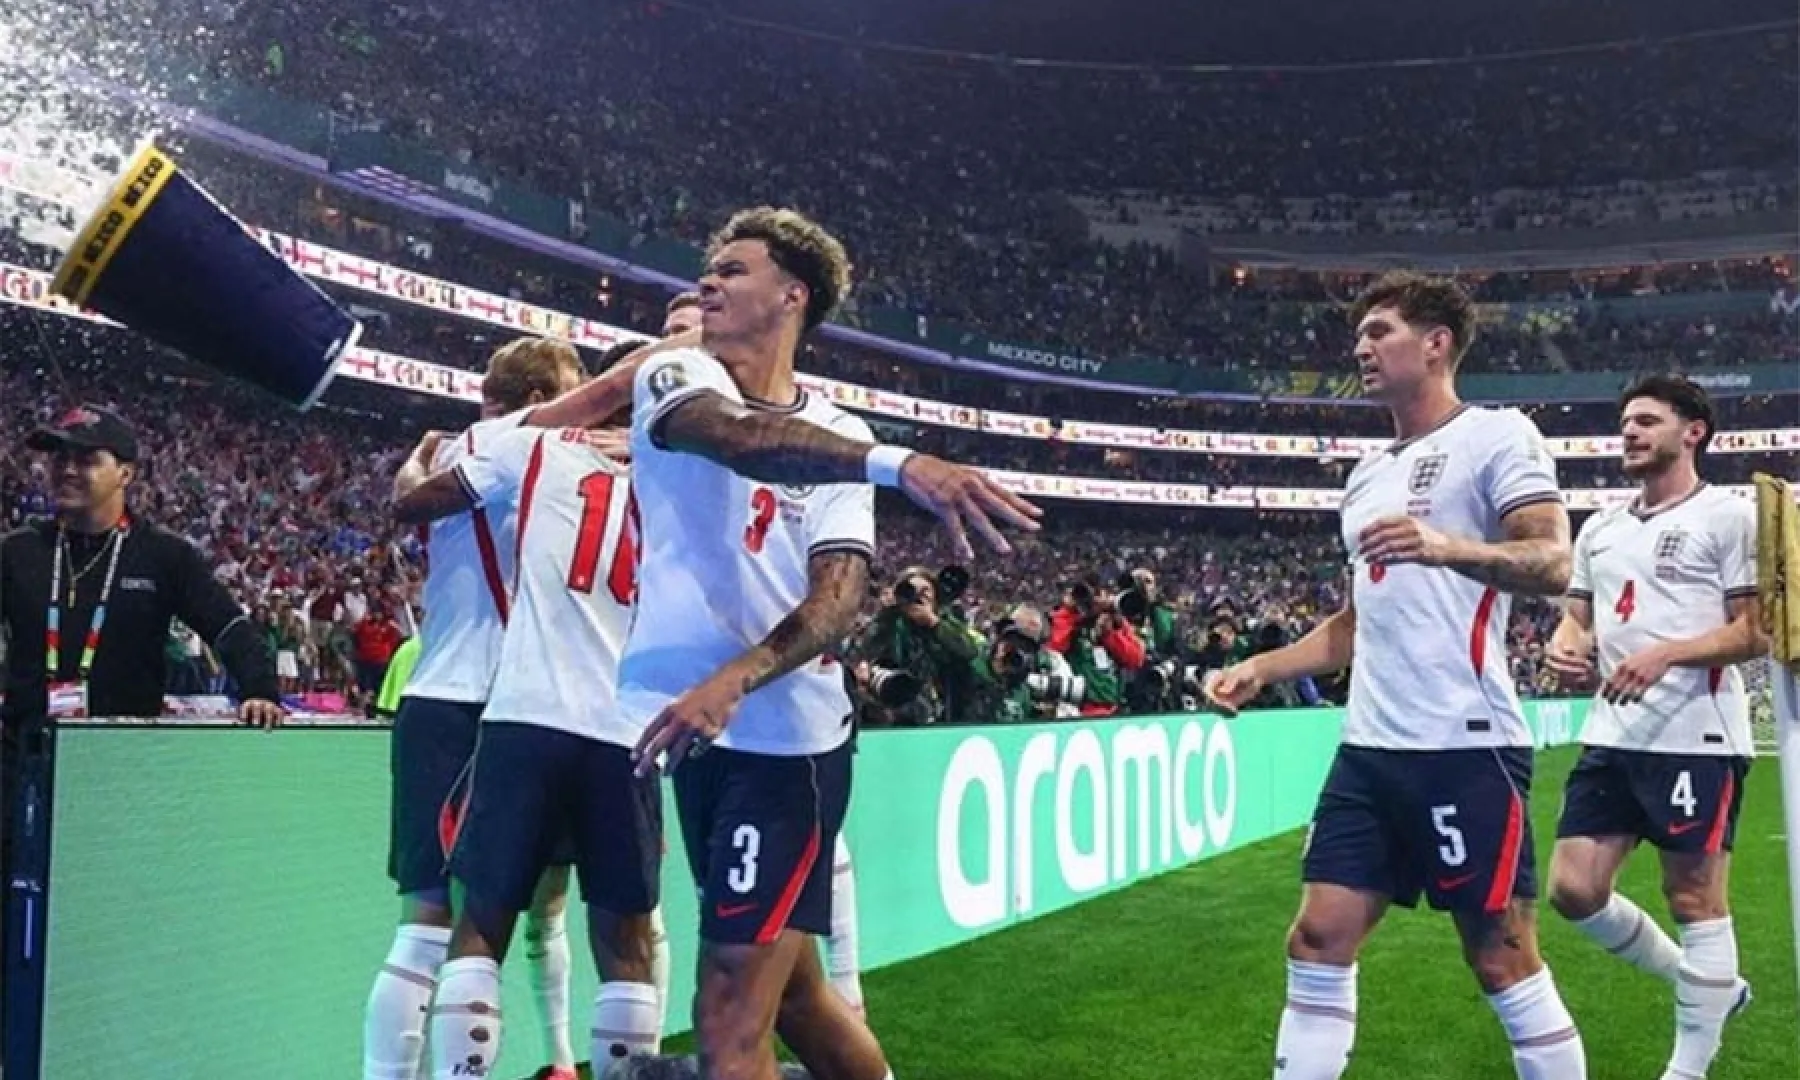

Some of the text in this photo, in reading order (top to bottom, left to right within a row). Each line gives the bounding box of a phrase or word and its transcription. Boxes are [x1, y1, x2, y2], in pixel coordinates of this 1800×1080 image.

[987, 341, 1103, 373] MEXICO CITY
[745, 487, 775, 553] 3
[1615, 579, 1635, 624] 4
[937, 719, 1236, 928] aramco
[1670, 769, 1697, 817] 4
[727, 823, 761, 894] 3
[1430, 804, 1467, 867] 5
